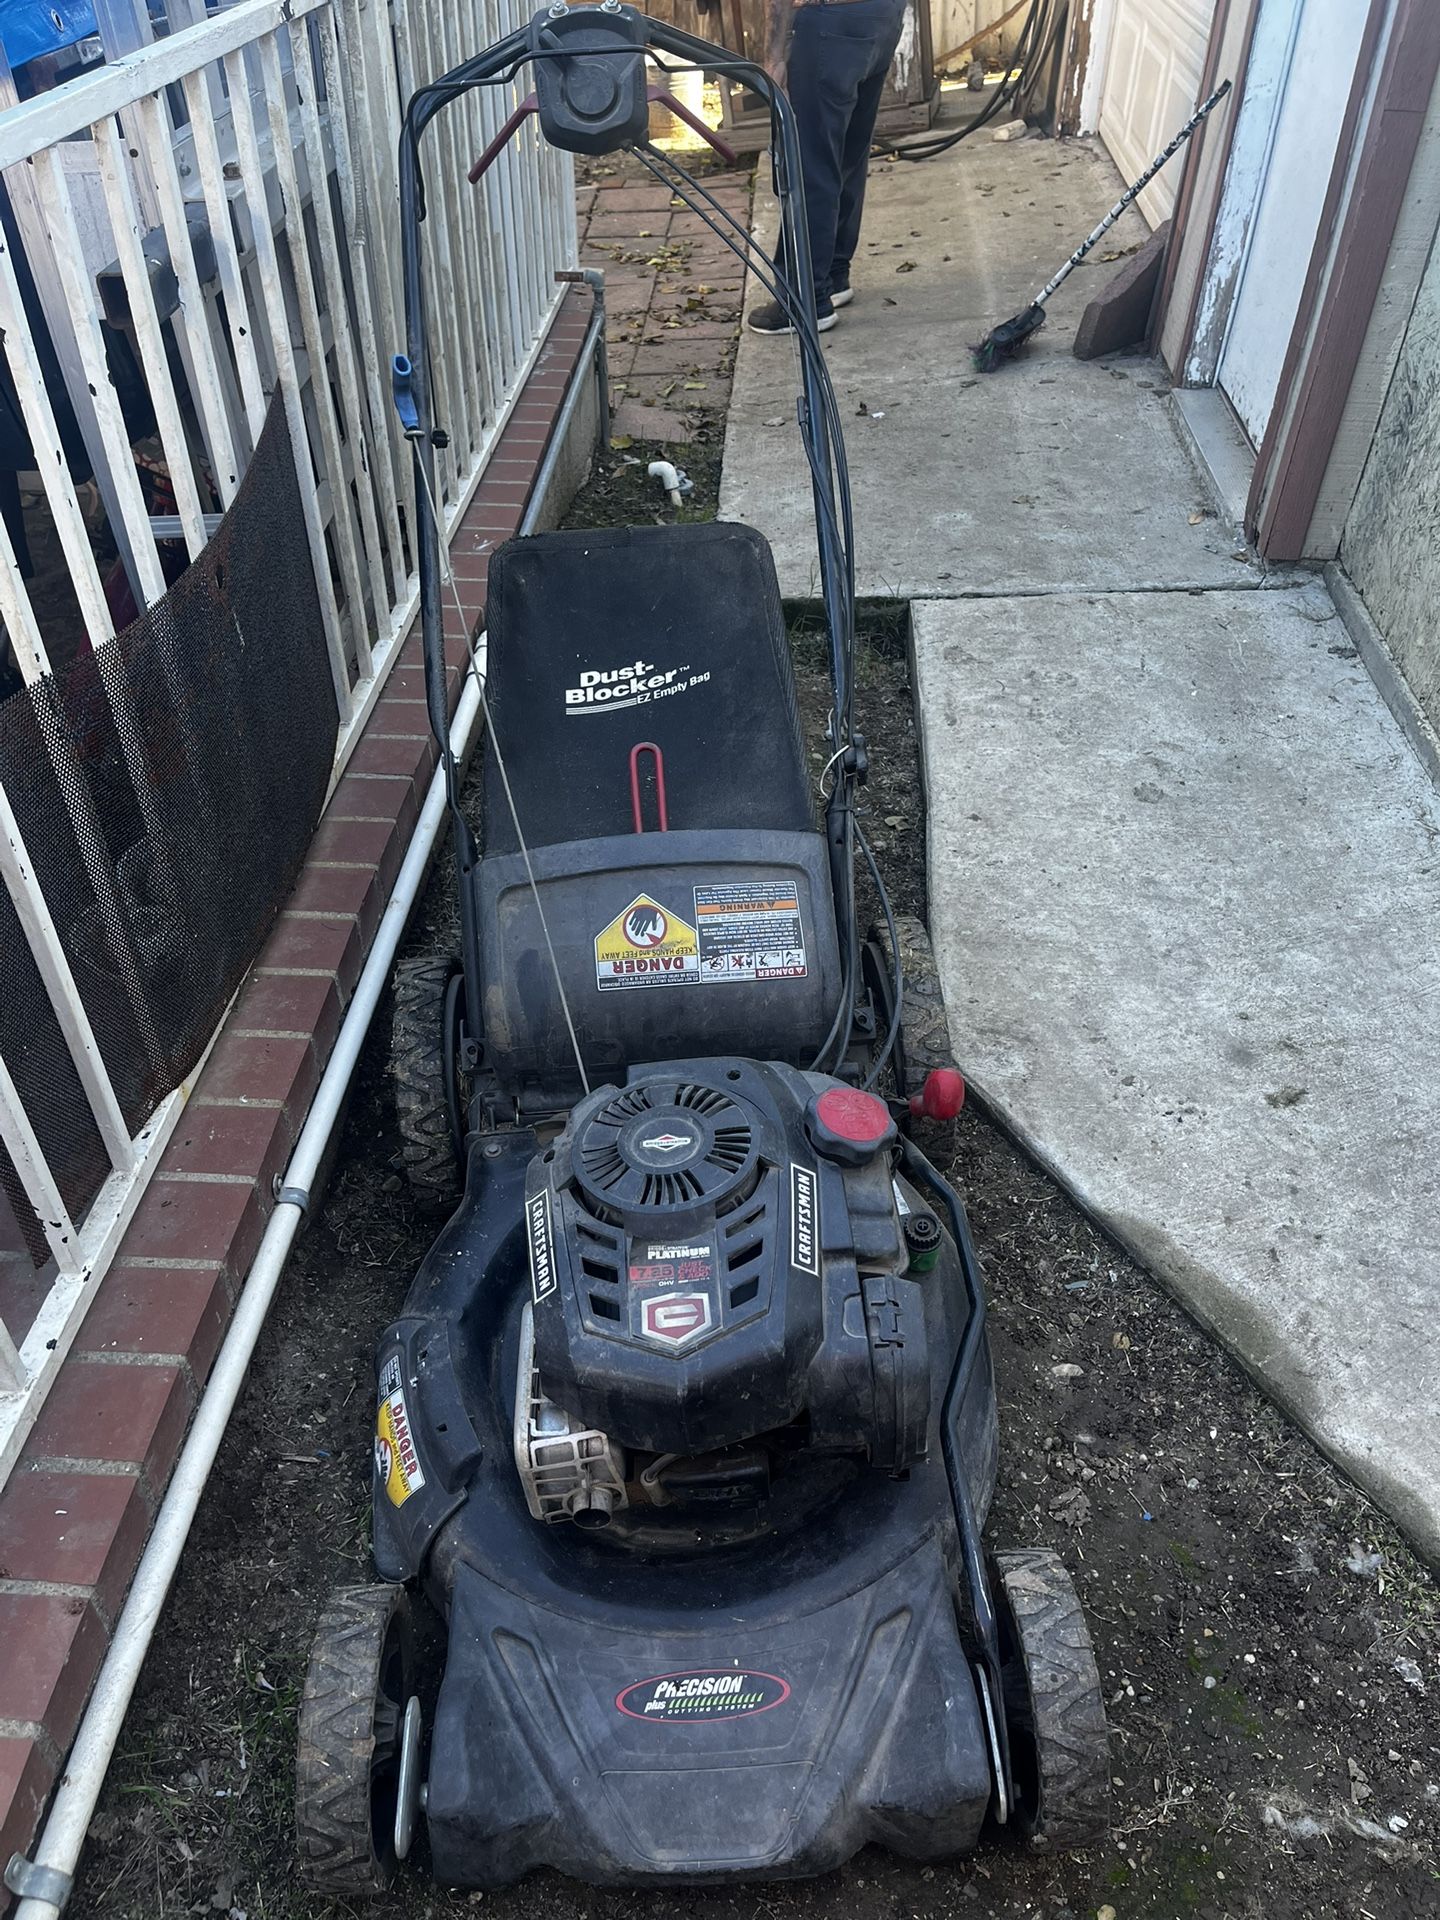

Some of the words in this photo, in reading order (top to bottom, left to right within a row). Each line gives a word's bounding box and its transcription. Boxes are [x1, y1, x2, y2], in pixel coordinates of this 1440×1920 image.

[580, 660, 655, 687] Dust-
[565, 669, 678, 704] Blocker
[637, 692, 651, 704] EZ
[653, 681, 688, 699] Empty
[689, 671, 711, 686] Bag
[719, 902, 765, 911] WARNING
[601, 952, 620, 960] AWAY
[652, 948, 674, 956] HANDS
[676, 946, 693, 954] KEEP
[612, 956, 684, 973] DANGER
[758, 967, 794, 977] DANGER
[798, 1172, 812, 1265] CRAFTSMAN
[532, 1199, 551, 1292] CRAFTSMAN
[648, 1246, 710, 1259] PLATINUM
[392, 1402, 418, 1478] DANGER
[644, 1700, 667, 1713] plus
[667, 1706, 711, 1714] CUTTING
